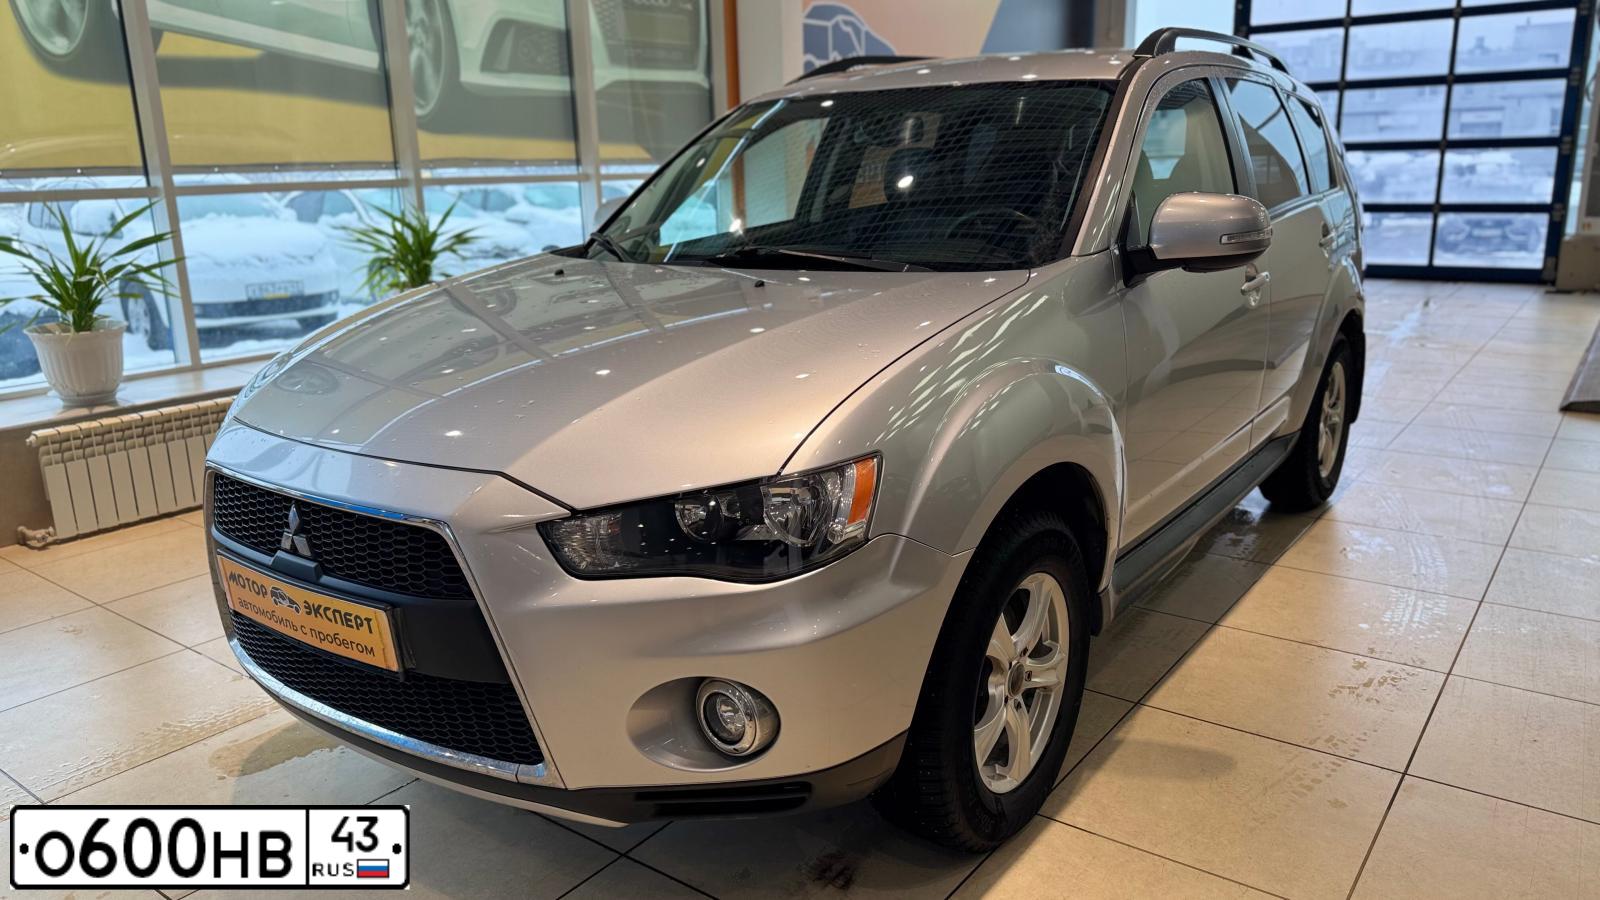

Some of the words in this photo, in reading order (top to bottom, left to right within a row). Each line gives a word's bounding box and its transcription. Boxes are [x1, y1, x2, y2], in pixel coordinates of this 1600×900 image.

[228, 570, 268, 598] МОТОР
[303, 600, 373, 634] ЭКСПЕРТ
[238, 597, 299, 632] автомобиль
[300, 625, 308, 636] с
[309, 629, 376, 657] пробегом
